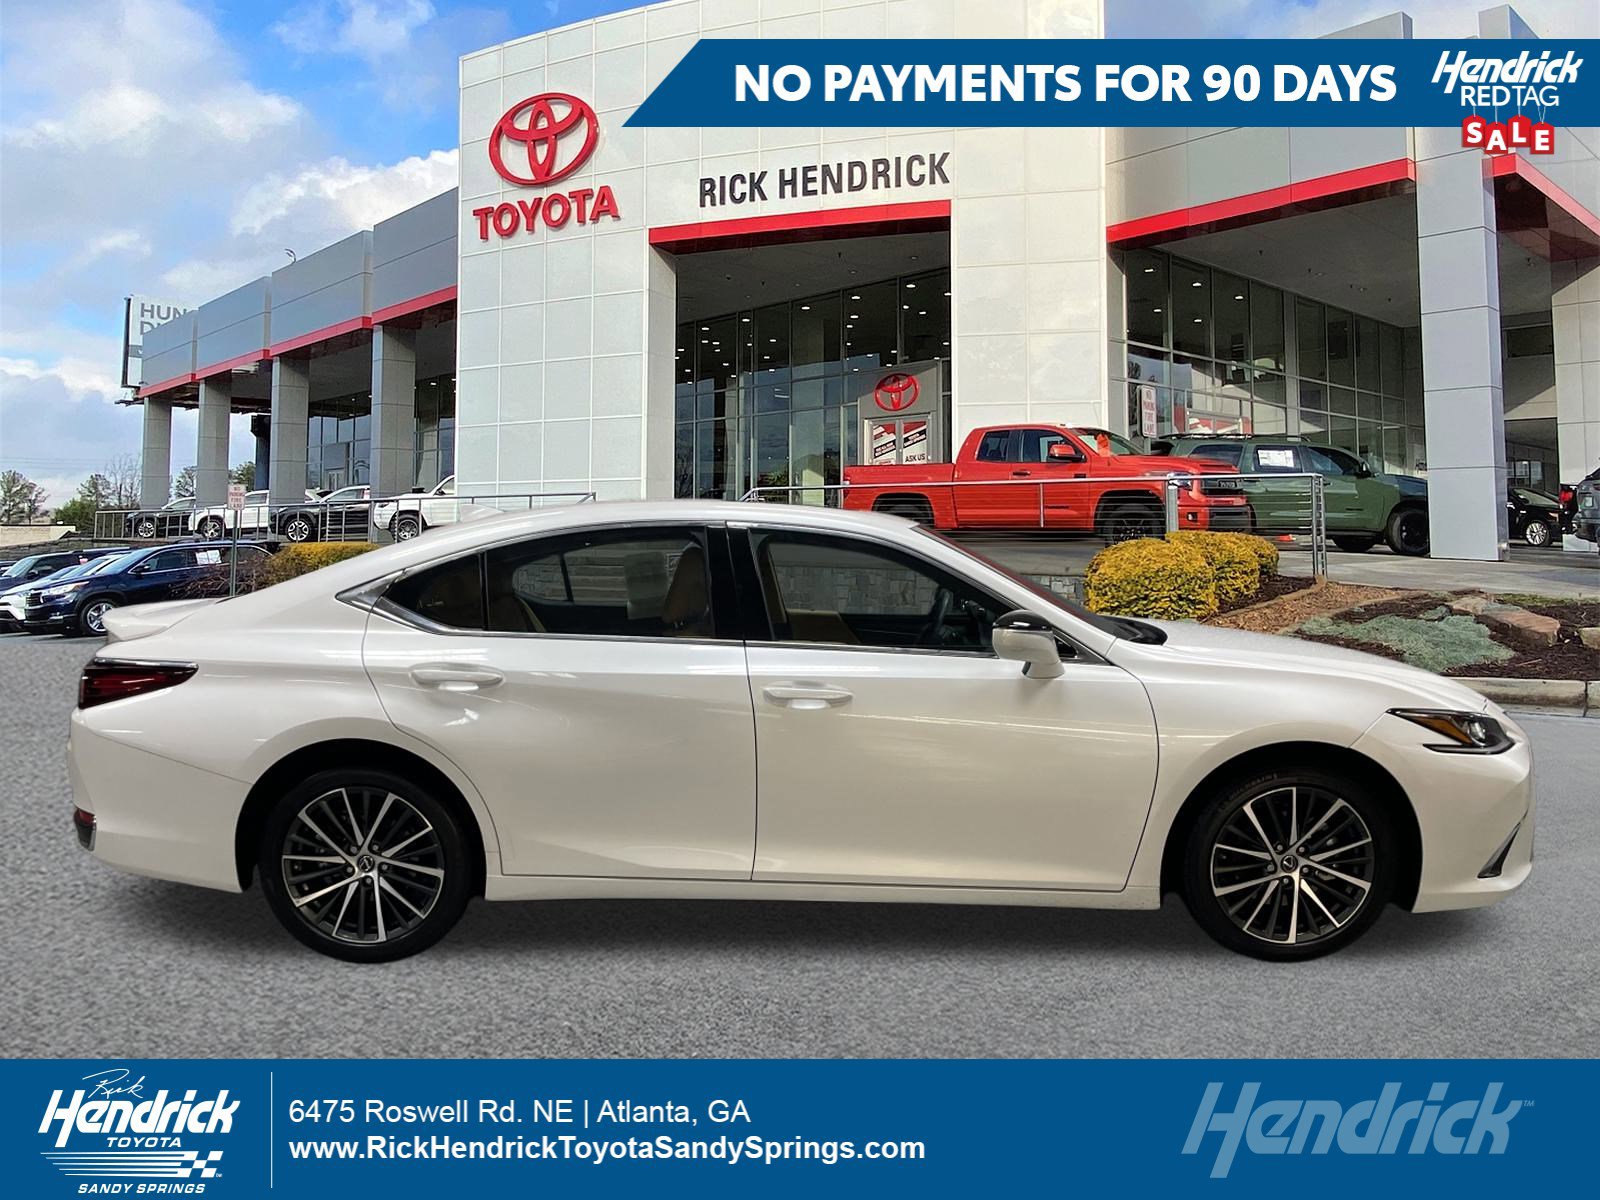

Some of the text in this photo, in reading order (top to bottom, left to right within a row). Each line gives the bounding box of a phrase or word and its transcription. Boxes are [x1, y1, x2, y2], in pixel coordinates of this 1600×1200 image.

[699, 152, 950, 207] RICK HENDRICK
[473, 185, 620, 240] TOYOTA
[905, 454, 917, 462] ASK
